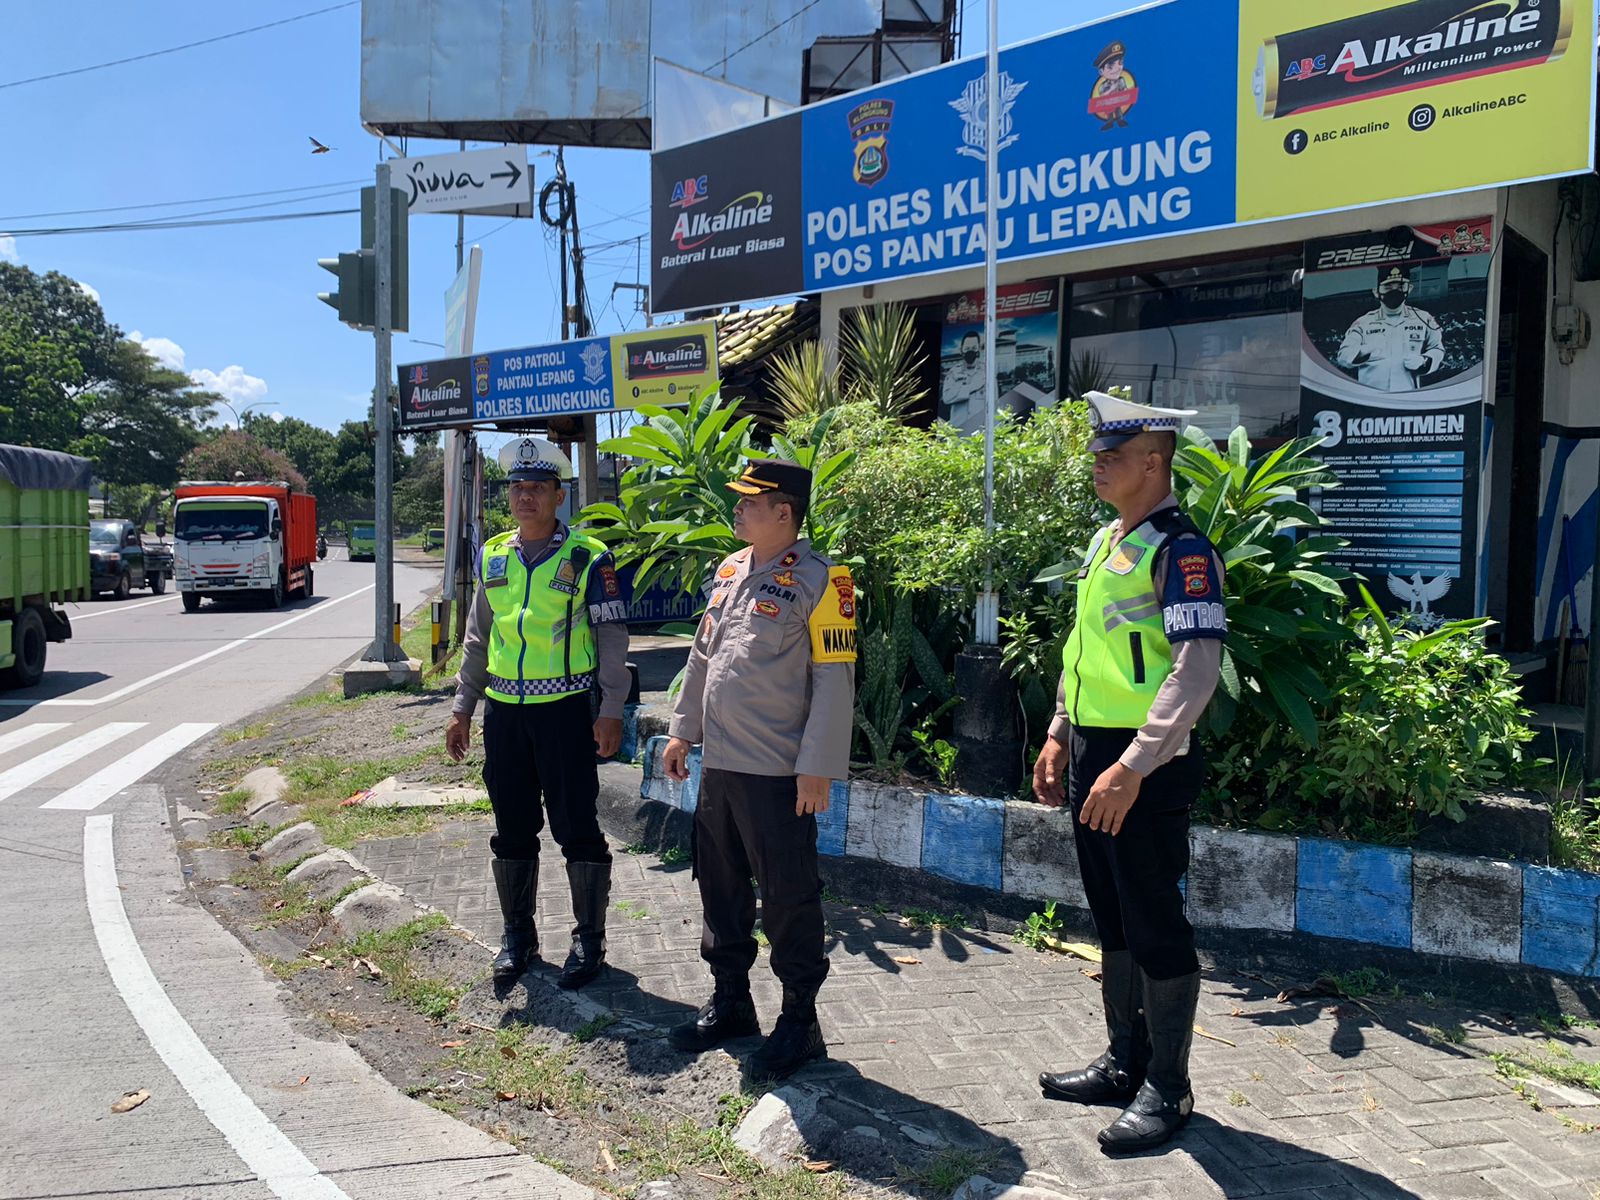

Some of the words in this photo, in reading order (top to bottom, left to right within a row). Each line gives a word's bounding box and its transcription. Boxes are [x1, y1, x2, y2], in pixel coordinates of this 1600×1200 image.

[1327, 9, 1541, 75] Alkaline
[1285, 55, 1326, 80] ABC
[1403, 52, 1487, 76] Millennium
[1494, 39, 1542, 57] Power
[1442, 93, 1527, 119] AlkalineABC
[1313, 130, 1337, 143] ABC
[1340, 120, 1390, 138] Alkaline
[670, 175, 708, 207] ABC
[807, 188, 931, 245] POLRES
[944, 130, 1212, 220] KLUNGKUNG
[671, 204, 772, 241] Alkaline
[814, 244, 872, 280] POS
[882, 217, 1014, 268] PANTAU
[1028, 187, 1191, 244] LEPANG
[661, 248, 706, 269] Baterai
[710, 245, 741, 259] Luar
[745, 237, 785, 253] Biasa
[504, 357, 522, 372] POS
[525, 350, 566, 369] PATROLI
[643, 349, 702, 365] Alkaline
[409, 366, 428, 383] ABC
[497, 373, 533, 391] PANTAU
[536, 369, 575, 387] LEPANG
[411, 386, 461, 403] Alkaline
[476, 397, 522, 418] POLRES
[525, 388, 610, 413] KLUNGKUNG
[432, 408, 447, 417] Luar
[1347, 414, 1464, 436] KOMITMEN
[760, 583, 796, 602] POLRI
